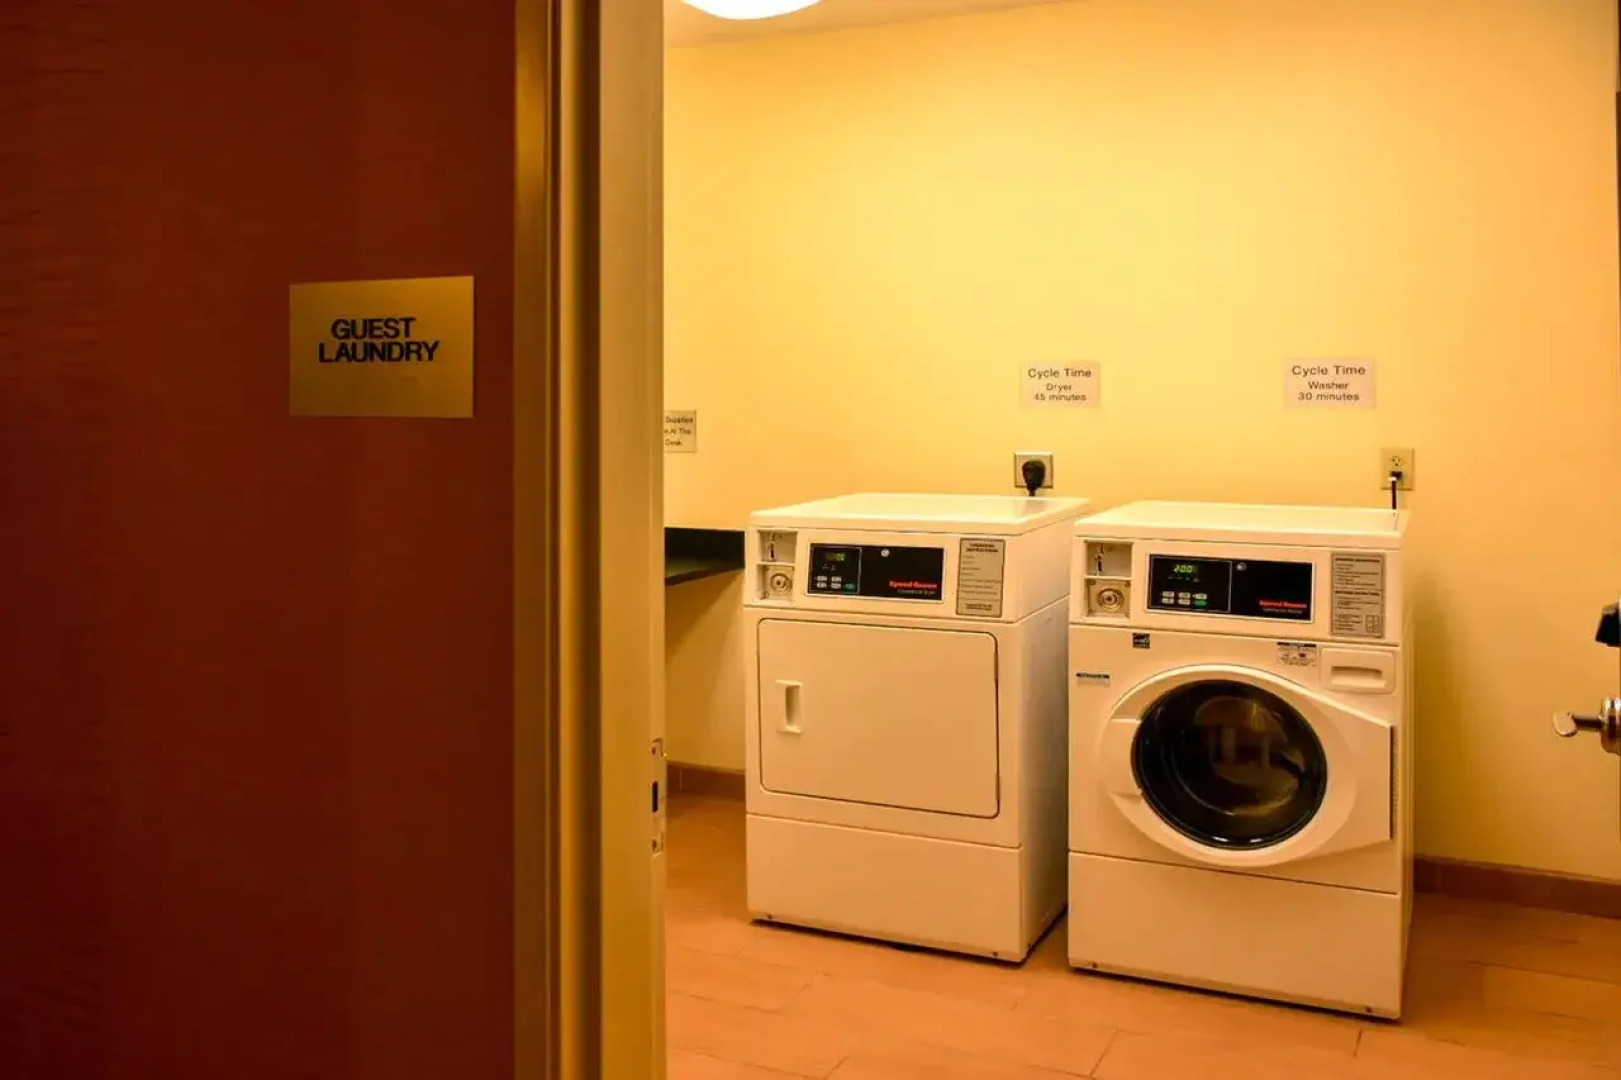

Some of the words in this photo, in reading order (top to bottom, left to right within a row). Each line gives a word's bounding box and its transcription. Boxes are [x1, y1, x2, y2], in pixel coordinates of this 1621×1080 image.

[331, 317, 416, 340] GUEST
[318, 340, 440, 363] LAUNDRY
[1027, 368, 1060, 380] Cycle
[1064, 368, 1092, 377] Time
[1291, 365, 1328, 377] Cycle
[1334, 365, 1366, 375] Time
[1046, 383, 1072, 392] Dryer
[1308, 381, 1349, 390] Washer
[1034, 393, 1045, 401] 45
[1298, 392, 1313, 401] 30
[1316, 393, 1360, 401] minutes
